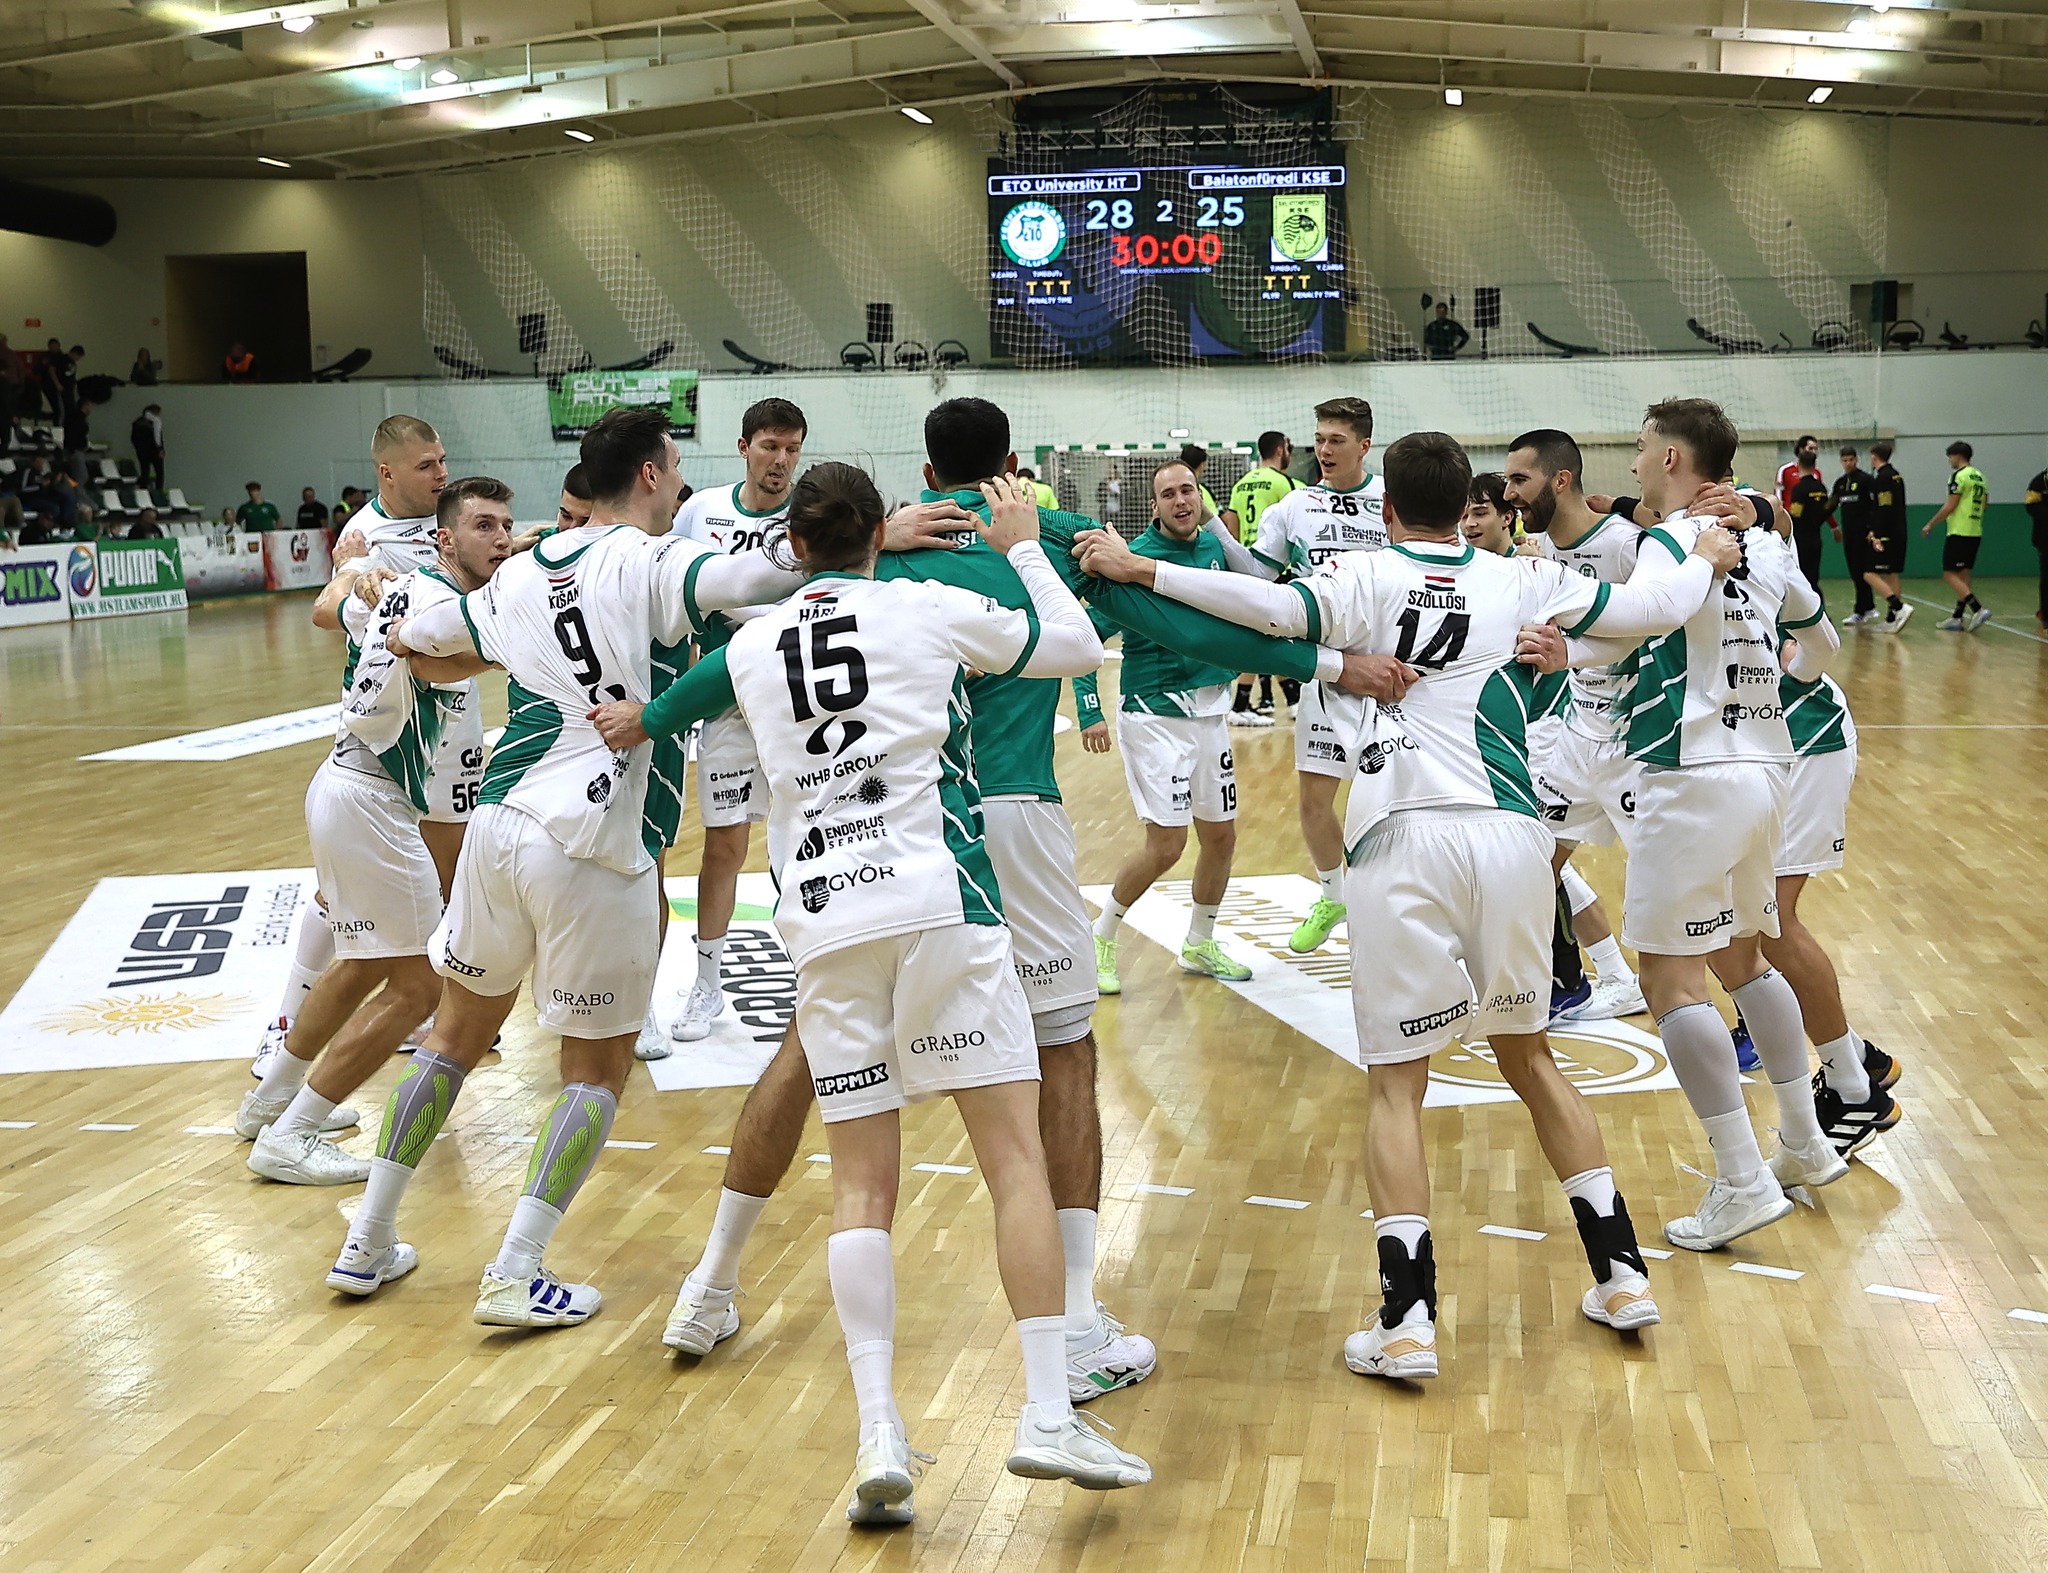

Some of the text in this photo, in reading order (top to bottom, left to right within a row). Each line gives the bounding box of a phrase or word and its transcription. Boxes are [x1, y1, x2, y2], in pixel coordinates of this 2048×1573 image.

[1002, 177, 1127, 193] ETO University HT
[1203, 171, 1330, 187] Balatonfüredi KSE
[1086, 200, 1135, 230] 28
[1156, 200, 1173, 222] 2
[1196, 196, 1244, 228] 25
[1111, 233, 1222, 266] 30:00
[1026, 280, 1071, 295] T T T
[1264, 275, 1311, 290] T T T
[1246, 494, 1256, 524] 5
[1329, 495, 1359, 516] 26
[100, 548, 158, 588] PUMA
[553, 606, 602, 687] 9
[1393, 606, 1471, 671] 14
[775, 613, 869, 724] 15
[1083, 693, 1099, 710] 19
[795, 768, 830, 790] WHB
[452, 781, 480, 813] 56
[1220, 782, 1237, 812] 19
[825, 816, 885, 840] ENDOPLUS
[829, 828, 888, 850] SERVICE
[828, 863, 896, 892] GYŐR
[1033, 978, 1053, 986] 1905
[553, 988, 615, 1007] GRABO
[910, 1030, 985, 1055] GRABO
[939, 1053, 960, 1062] 1905
